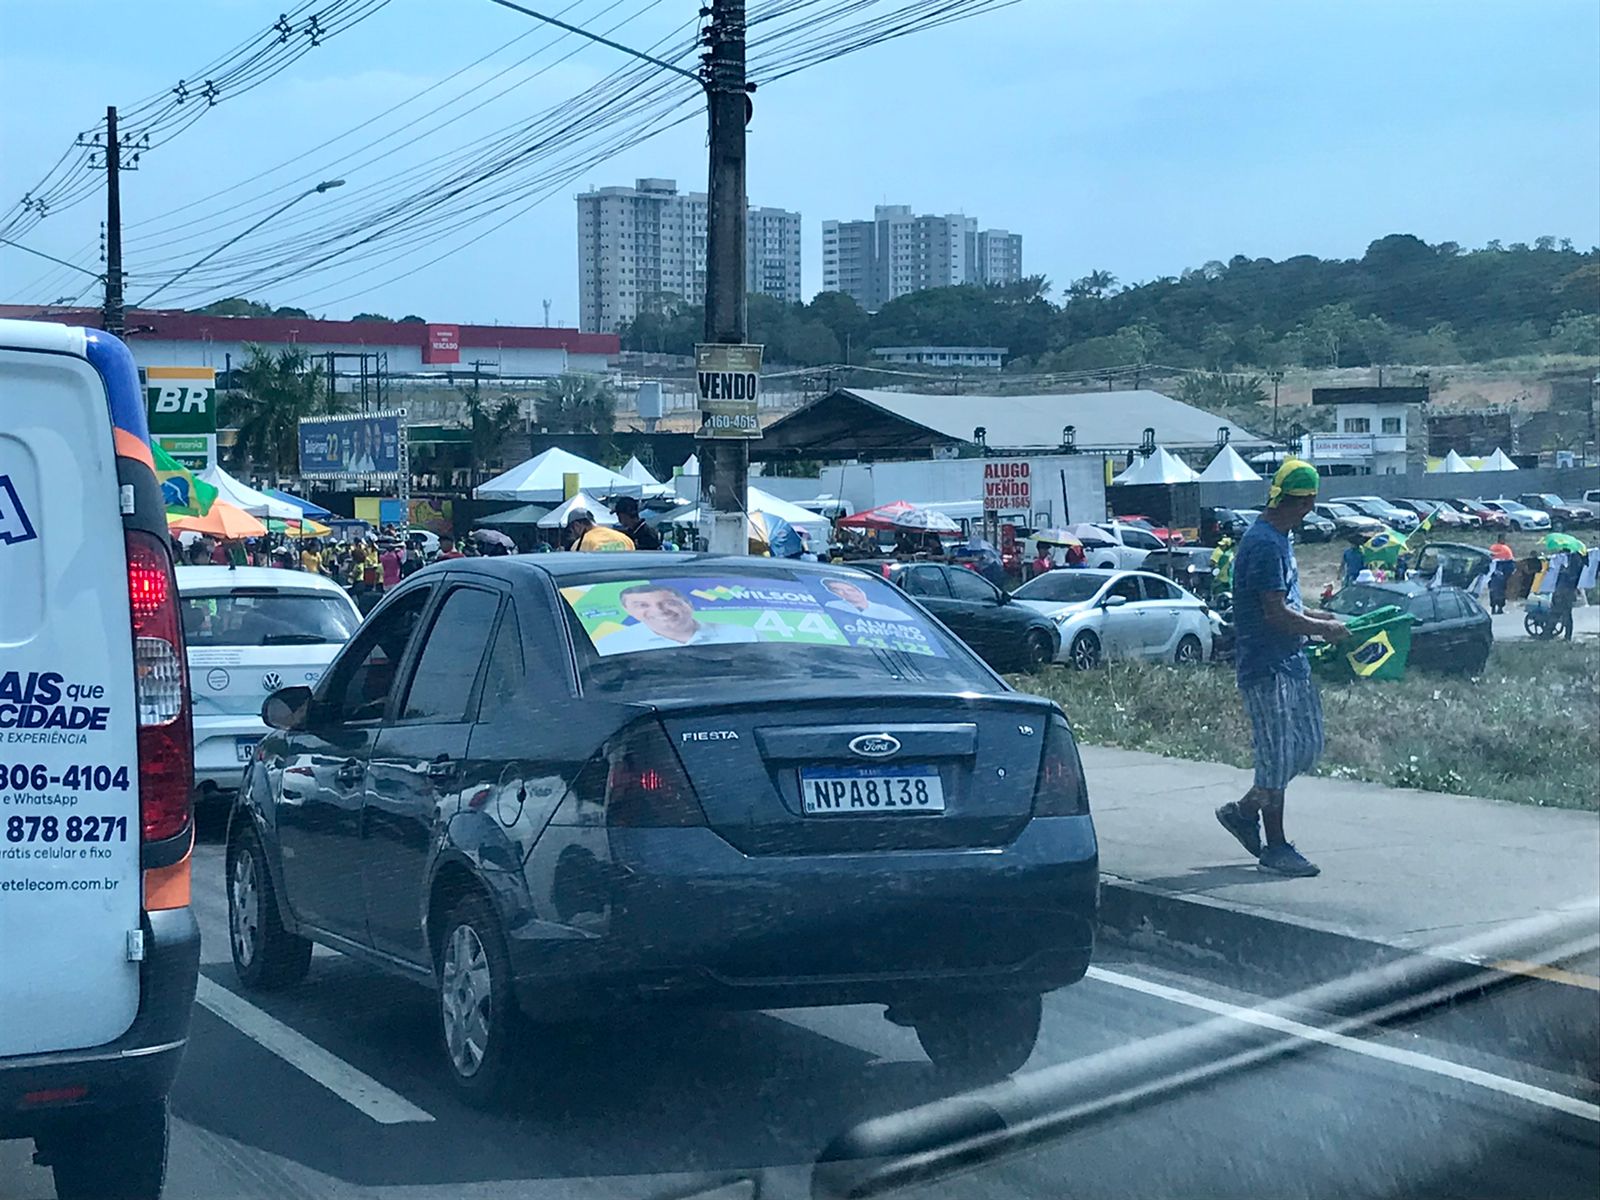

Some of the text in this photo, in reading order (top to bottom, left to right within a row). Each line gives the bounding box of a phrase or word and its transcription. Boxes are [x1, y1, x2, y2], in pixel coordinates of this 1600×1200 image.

[698, 372, 757, 401] VENDO
[155, 386, 209, 413] BR
[984, 462, 1030, 479] ALUGO
[986, 482, 1029, 496] VENDO
[728, 590, 817, 603] WILSON
[753, 609, 840, 641] 44
[66, 684, 104, 702] que
[0, 704, 110, 730] CIDADE
[8, 732, 88, 744] EXPERIÊNCIA
[682, 731, 739, 742] FIESTA
[3, 793, 78, 807] e WhatsApp
[814, 779, 929, 808] NPA8I38
[6, 815, 127, 842] 878 8271
[0, 846, 112, 859] rátis celular e fixo
[0, 877, 119, 891] etelecom.com.br
